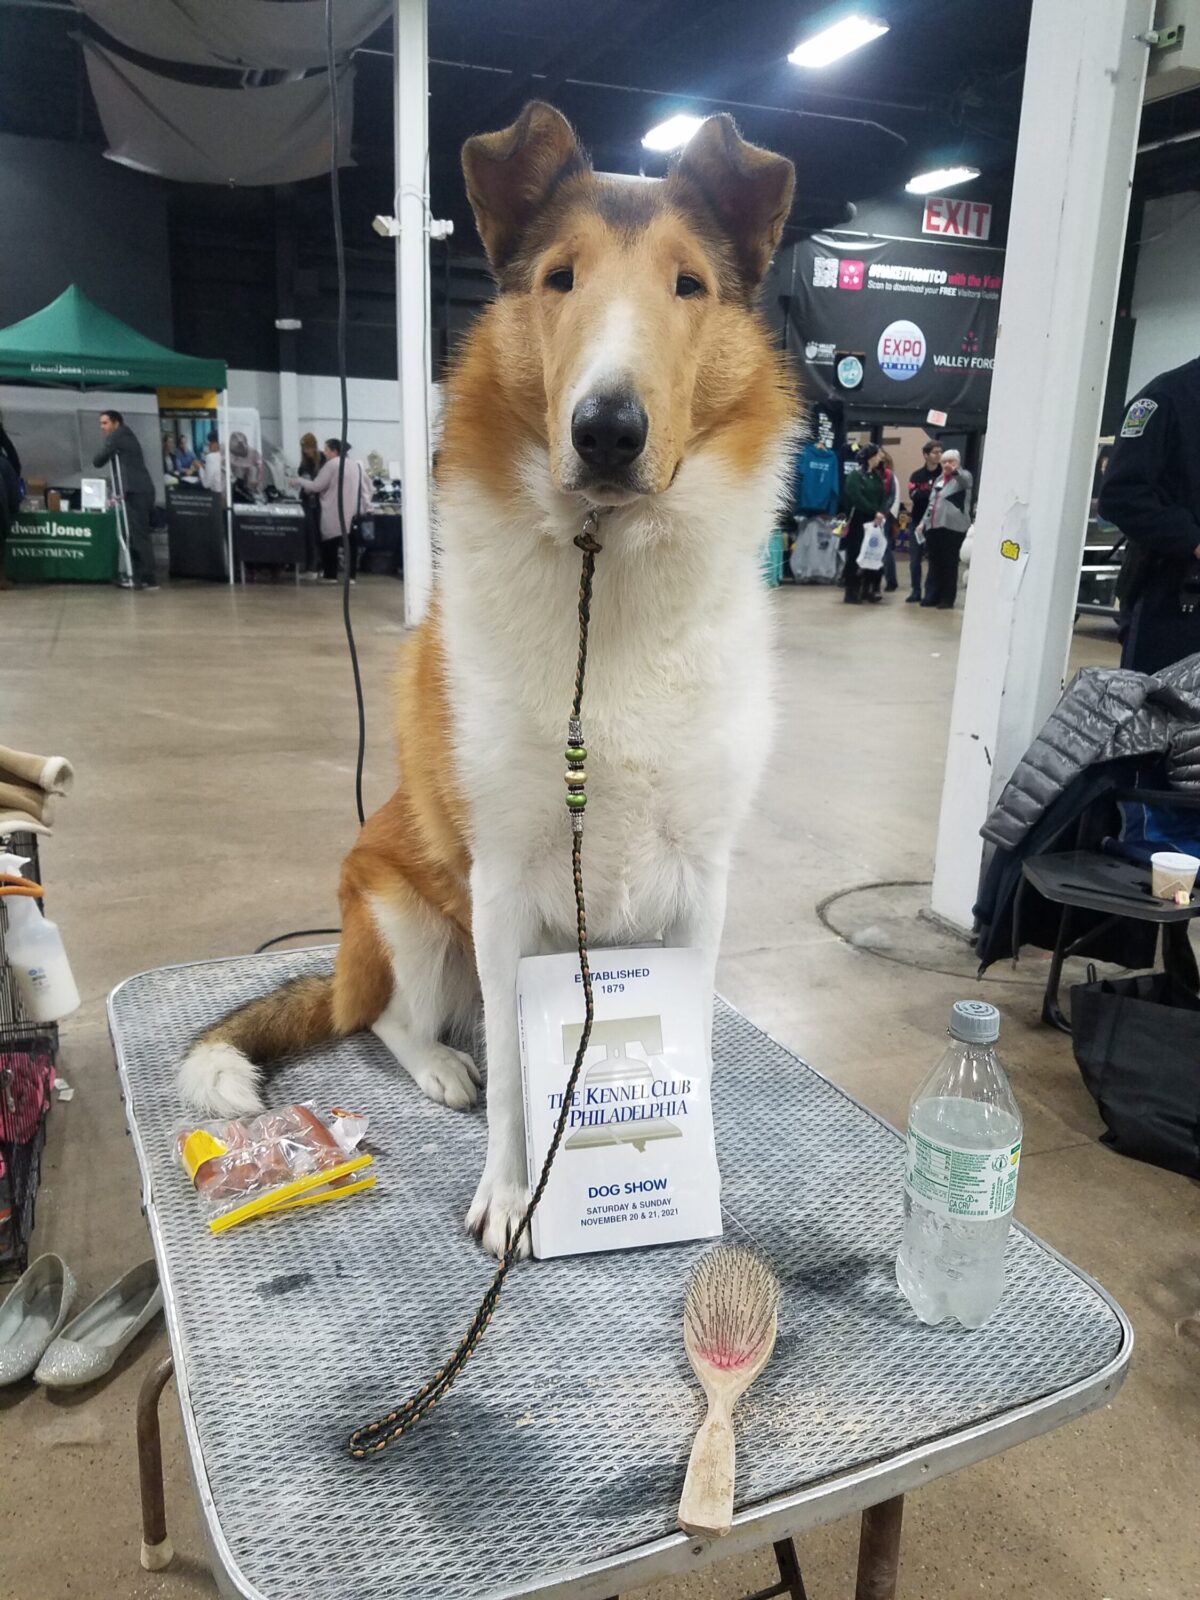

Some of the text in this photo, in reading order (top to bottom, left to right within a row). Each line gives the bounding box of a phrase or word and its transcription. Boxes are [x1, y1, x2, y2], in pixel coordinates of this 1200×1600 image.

[926, 199, 989, 237] EXIT
[868, 280, 884, 290] Scan
[885, 282, 892, 290] to
[893, 282, 924, 294] download
[924, 286, 939, 296] your
[939, 287, 957, 296] FREE
[883, 339, 921, 357] EXPO
[933, 354, 995, 369] VALLEY FORG
[11, 521, 92, 538] dwardJones
[12, 547, 84, 559] INVESTMENTS
[574, 968, 650, 983] ETABLISHED
[602, 984, 625, 994] 1879
[586, 1084, 649, 1105] KENNEL
[652, 1079, 690, 1097] CLUB
[569, 1100, 688, 1127] PHILADELPHIA
[588, 1178, 667, 1198] DOG SHOW
[586, 1203, 629, 1215] SATURDAY
[640, 1198, 672, 1208] SUNDAY
[581, 1214, 627, 1226] NOVEMBER
[649, 1211, 660, 1219] 21,
[661, 1208, 679, 1217] 2021
